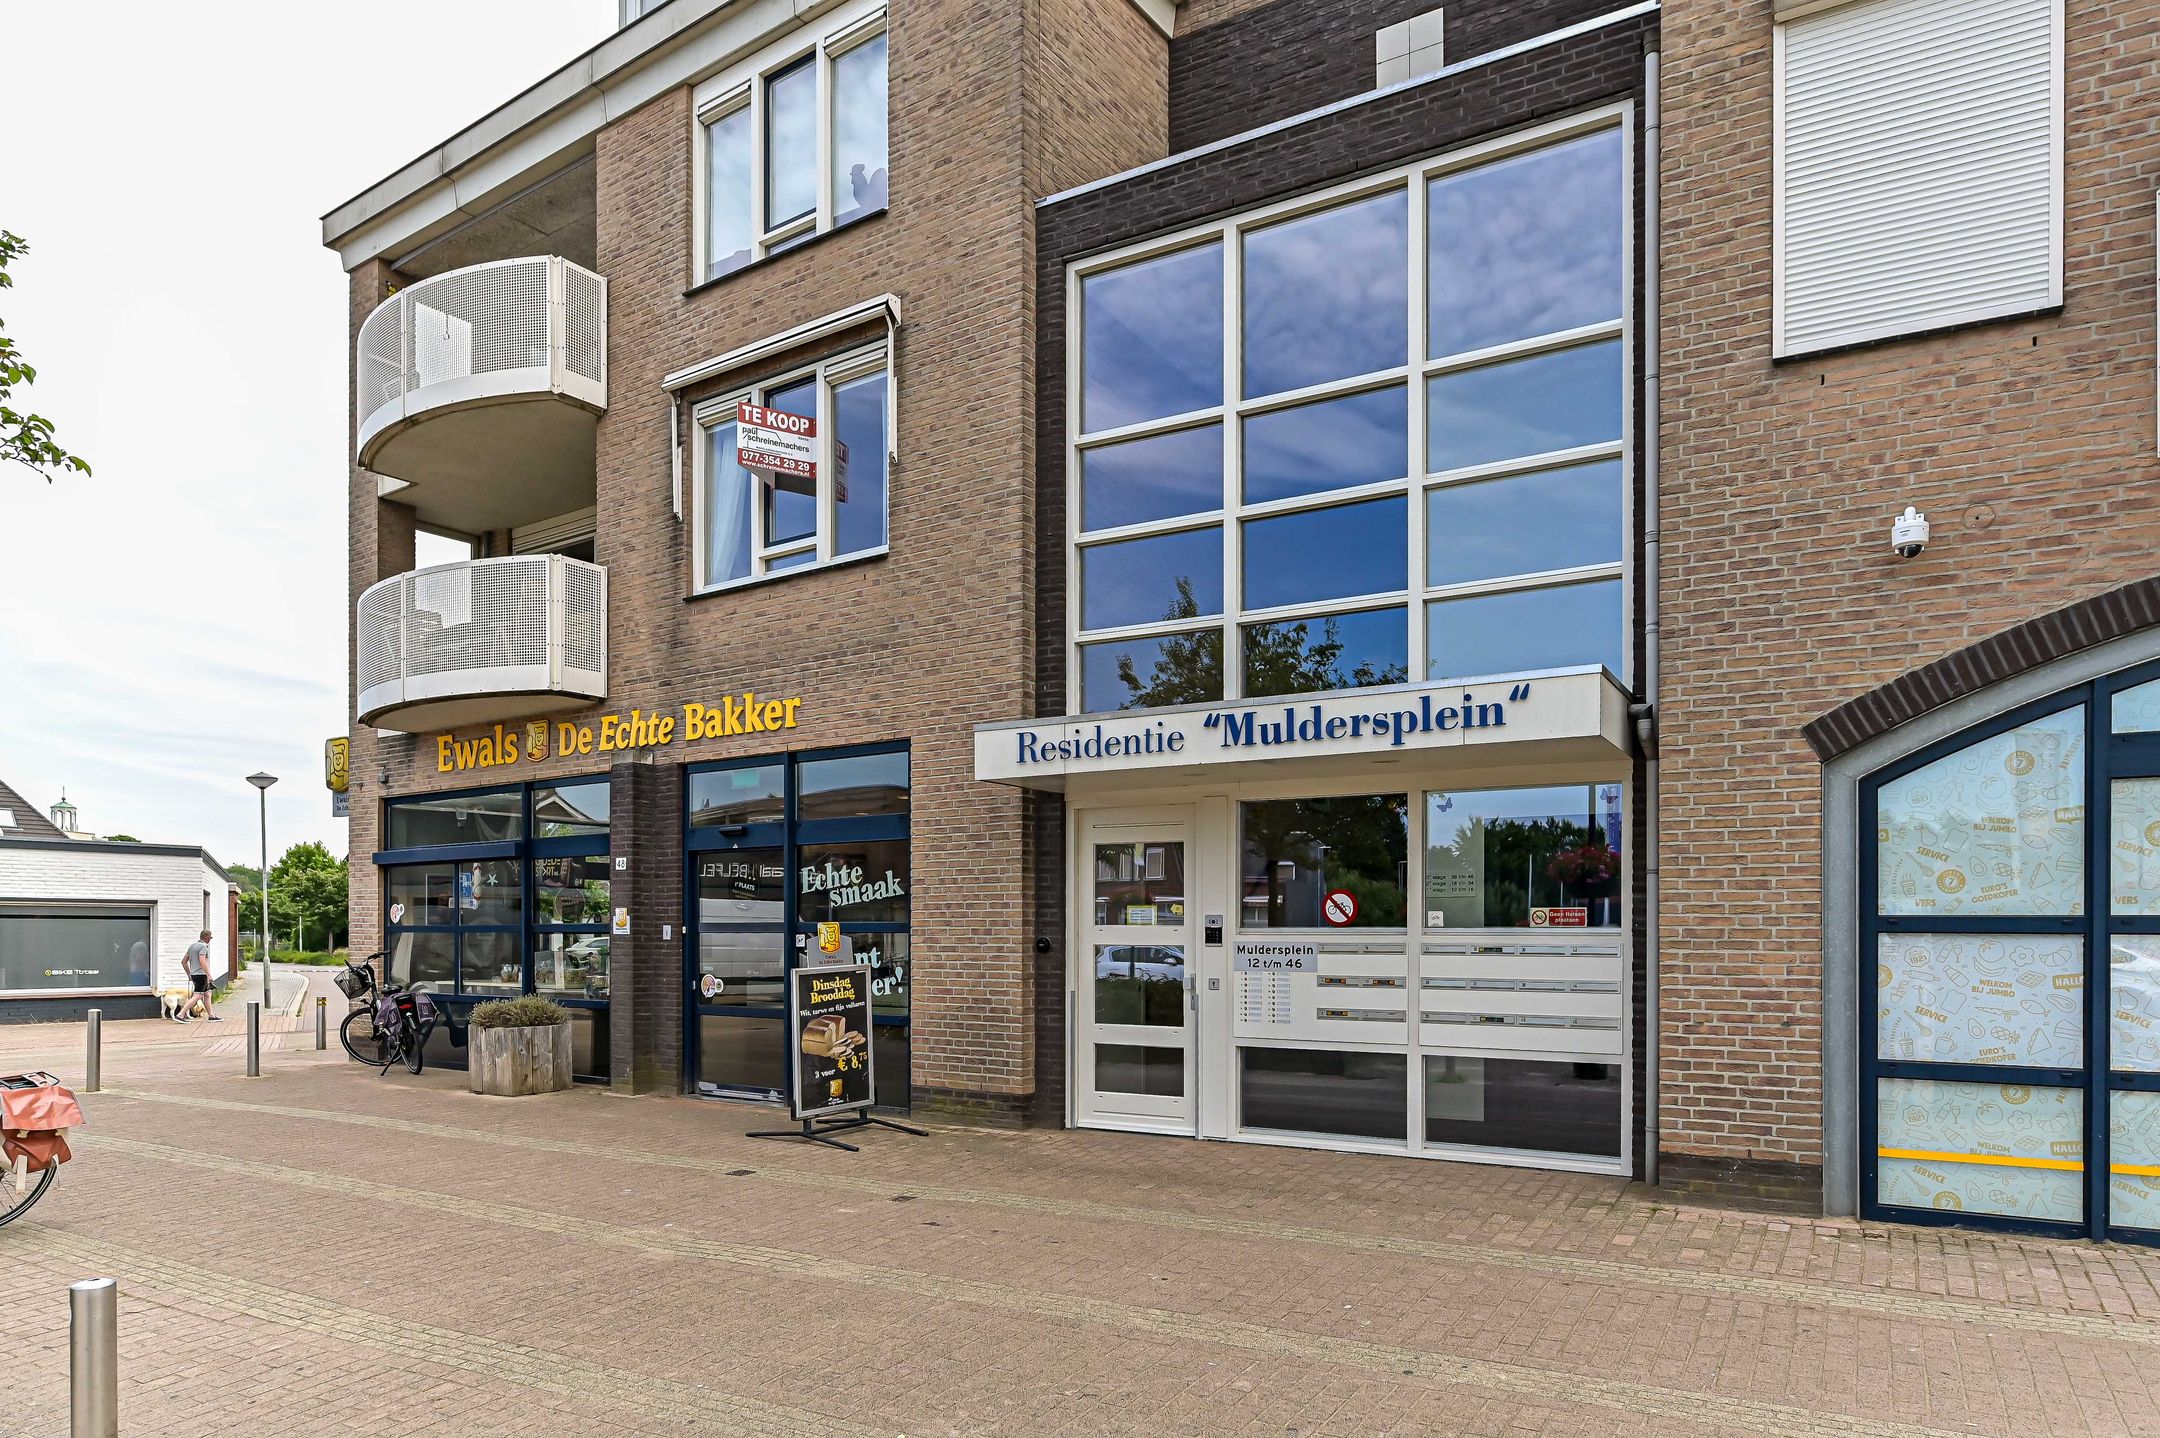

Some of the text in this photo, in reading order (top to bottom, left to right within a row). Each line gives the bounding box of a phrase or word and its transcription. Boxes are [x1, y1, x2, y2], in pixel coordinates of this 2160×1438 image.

[742, 405, 809, 433] TE KOOP
[747, 435, 810, 453] schreinemachers
[742, 451, 780, 466] 077-354
[783, 459, 795, 468] 29
[797, 462, 810, 471] 29
[437, 692, 801, 773] Ewals De Echte Bakker
[1016, 721, 1185, 763] Residentie
[1982, 816, 2014, 824] WELKOM
[1973, 823, 2017, 833] BIJ JUMBO
[1916, 846, 1950, 862] SERVICE
[2116, 840, 2154, 857] SERVICE
[616, 860, 626, 869] 48
[800, 863, 863, 894] Echte
[829, 870, 905, 907] smaak
[1972, 889, 2018, 903] GOEDKOPER
[1915, 899, 1937, 907] VERS
[2115, 896, 2139, 904] VERS
[1237, 945, 1313, 956] Muldersplein
[1248, 958, 1303, 969] 12 t/m 46
[1910, 954, 1927, 964] 1921
[812, 976, 851, 992] Dinsdag
[1971, 985, 2015, 998] BIJ JUMBO
[1980, 979, 2013, 989] WELKOM
[810, 987, 856, 1005] Brooddag
[1914, 1006, 1949, 1024] SERVICE
[2114, 1009, 2152, 1029] SERVICE
[1979, 1046, 2006, 1057] EURO'S
[837, 1056, 848, 1071] €
[821, 1069, 836, 1077] voor
[1977, 1140, 2011, 1154] WELKOM
[1913, 1165, 1946, 1184] SERVICE
[2111, 1179, 2151, 1200] SERVICE
